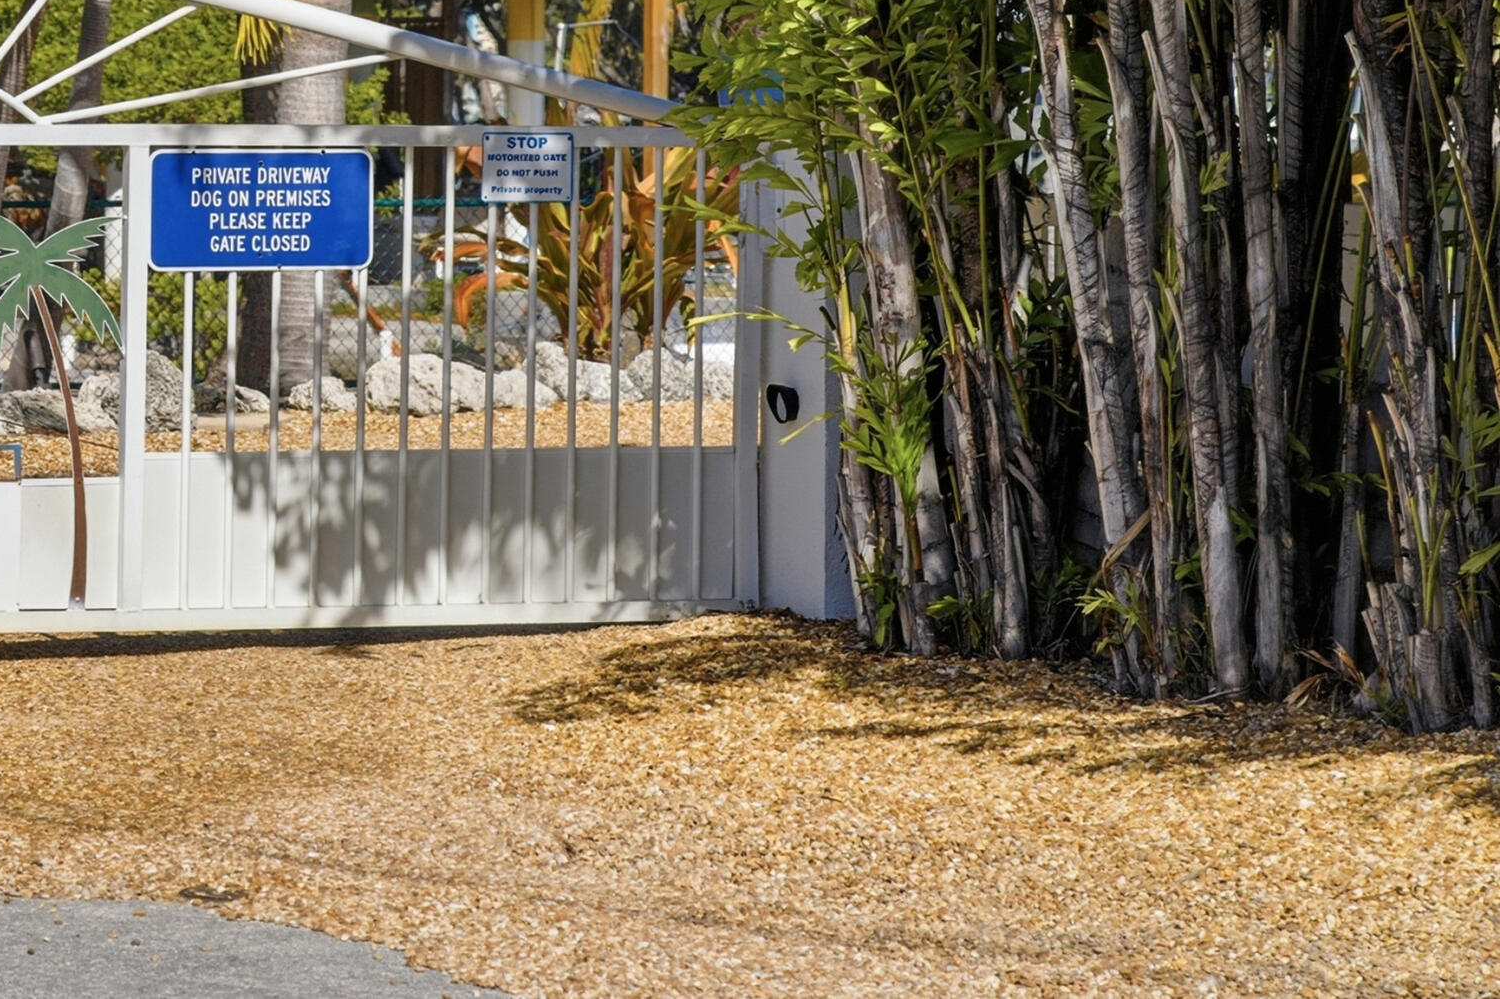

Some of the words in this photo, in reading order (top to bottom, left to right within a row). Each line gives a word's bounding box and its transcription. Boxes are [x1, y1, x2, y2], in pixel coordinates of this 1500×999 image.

[506, 136, 548, 150] STOP
[487, 153, 541, 162] MOTORIZED
[542, 153, 568, 162] GATE
[191, 167, 252, 185] PRIVATE
[257, 166, 331, 184] DRIVEWAY
[496, 168, 510, 177] DO
[511, 168, 531, 177] NOT
[533, 168, 559, 178] PUSH
[491, 185, 522, 194] Private
[524, 185, 563, 195] property
[190, 190, 223, 208] DOG
[228, 190, 250, 207] ON
[255, 189, 331, 208] PREMISES
[209, 213, 267, 230] PLEASE
[272, 212, 312, 230] KEEP
[210, 235, 246, 253] GATE
[251, 235, 311, 252] CLOSED
